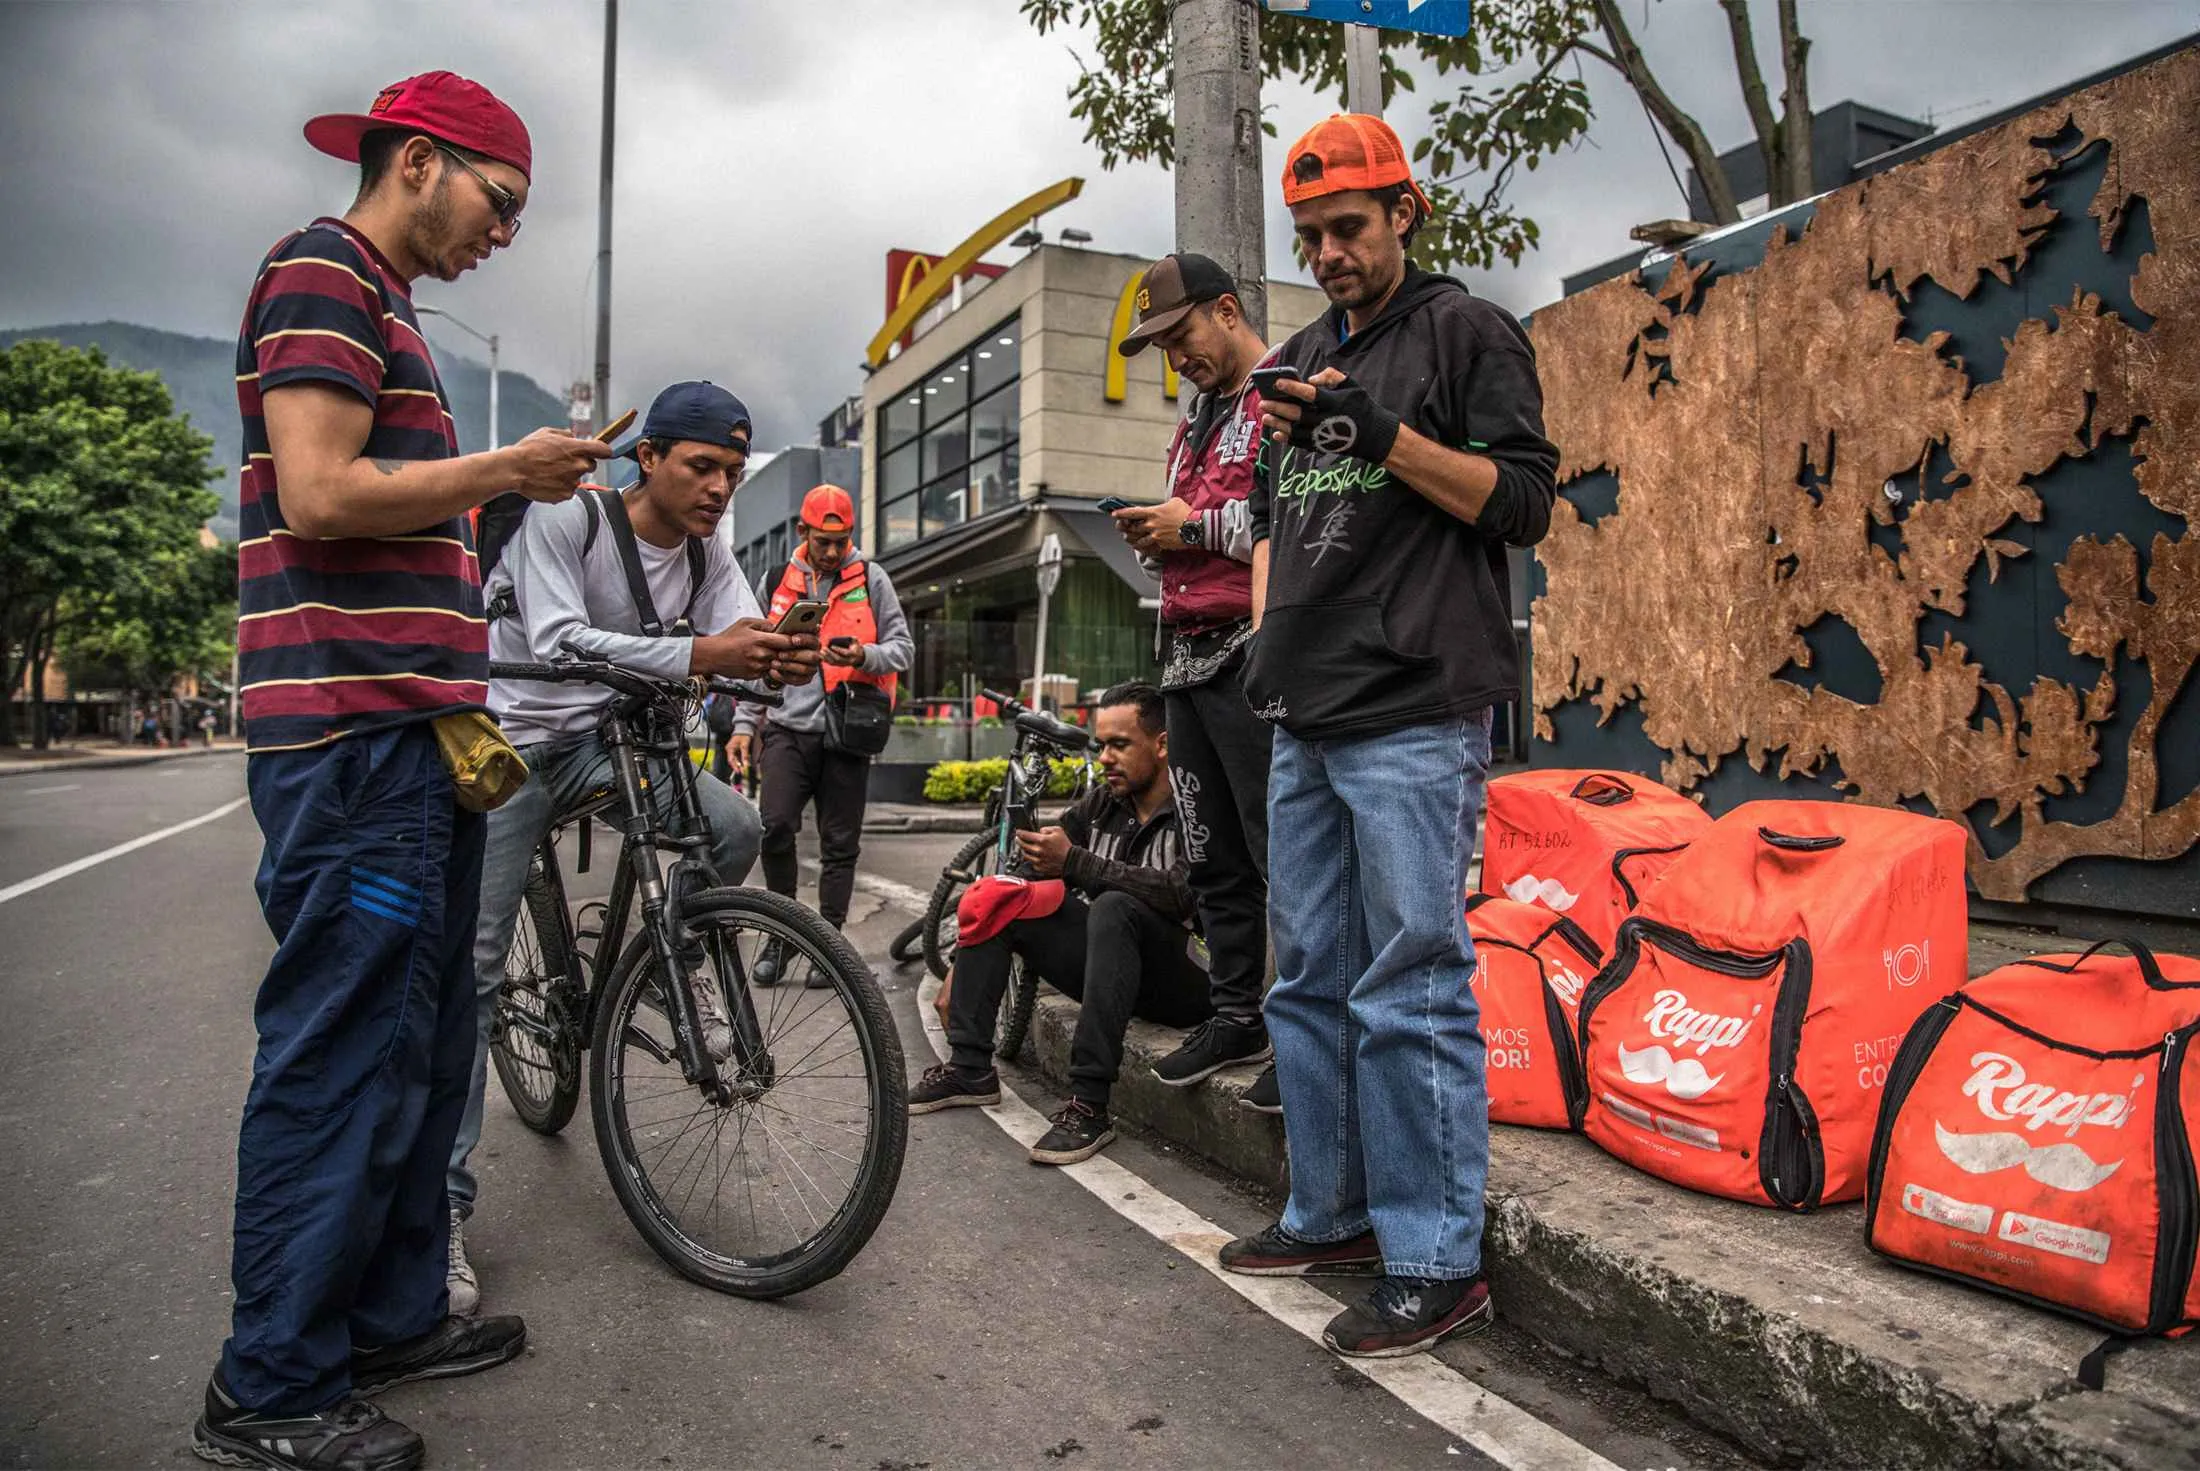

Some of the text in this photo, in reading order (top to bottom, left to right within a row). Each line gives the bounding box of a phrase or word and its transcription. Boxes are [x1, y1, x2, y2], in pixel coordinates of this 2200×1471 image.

[1643, 989, 1763, 1056] Rappi
[1483, 1027, 1529, 1046] MOS
[1858, 1062, 1892, 1089] CO
[1962, 1051, 2144, 1137] Rappi
[2034, 1231, 2074, 1250] Google
